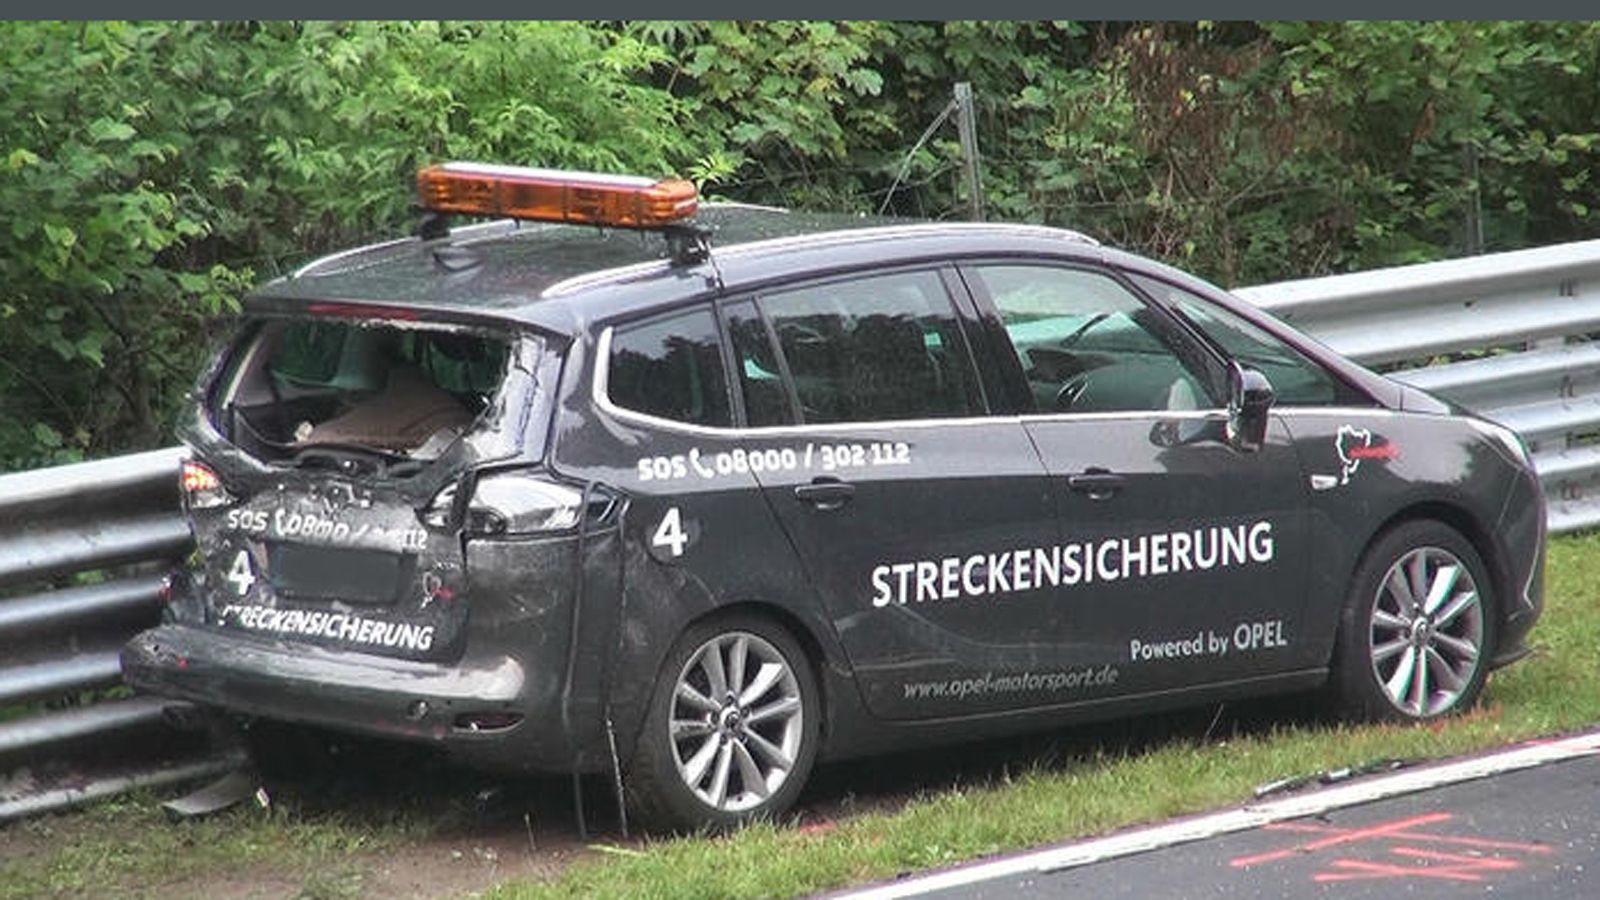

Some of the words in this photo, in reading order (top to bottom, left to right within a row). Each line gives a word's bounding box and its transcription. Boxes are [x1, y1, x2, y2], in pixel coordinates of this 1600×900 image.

[638, 456, 687, 480] SOS
[716, 448, 797, 475] 08000
[820, 443, 866, 470] 302
[870, 442, 911, 465] 112
[228, 509, 268, 531] SOS
[652, 507, 688, 556] 4
[229, 550, 256, 595] 4
[872, 521, 1274, 608] STRECKENSICHERUNG
[1130, 631, 1204, 661] Powered
[1208, 630, 1229, 655] by
[1233, 620, 1288, 650] OPEL
[904, 665, 1119, 699] www.opel-motorsport.de
